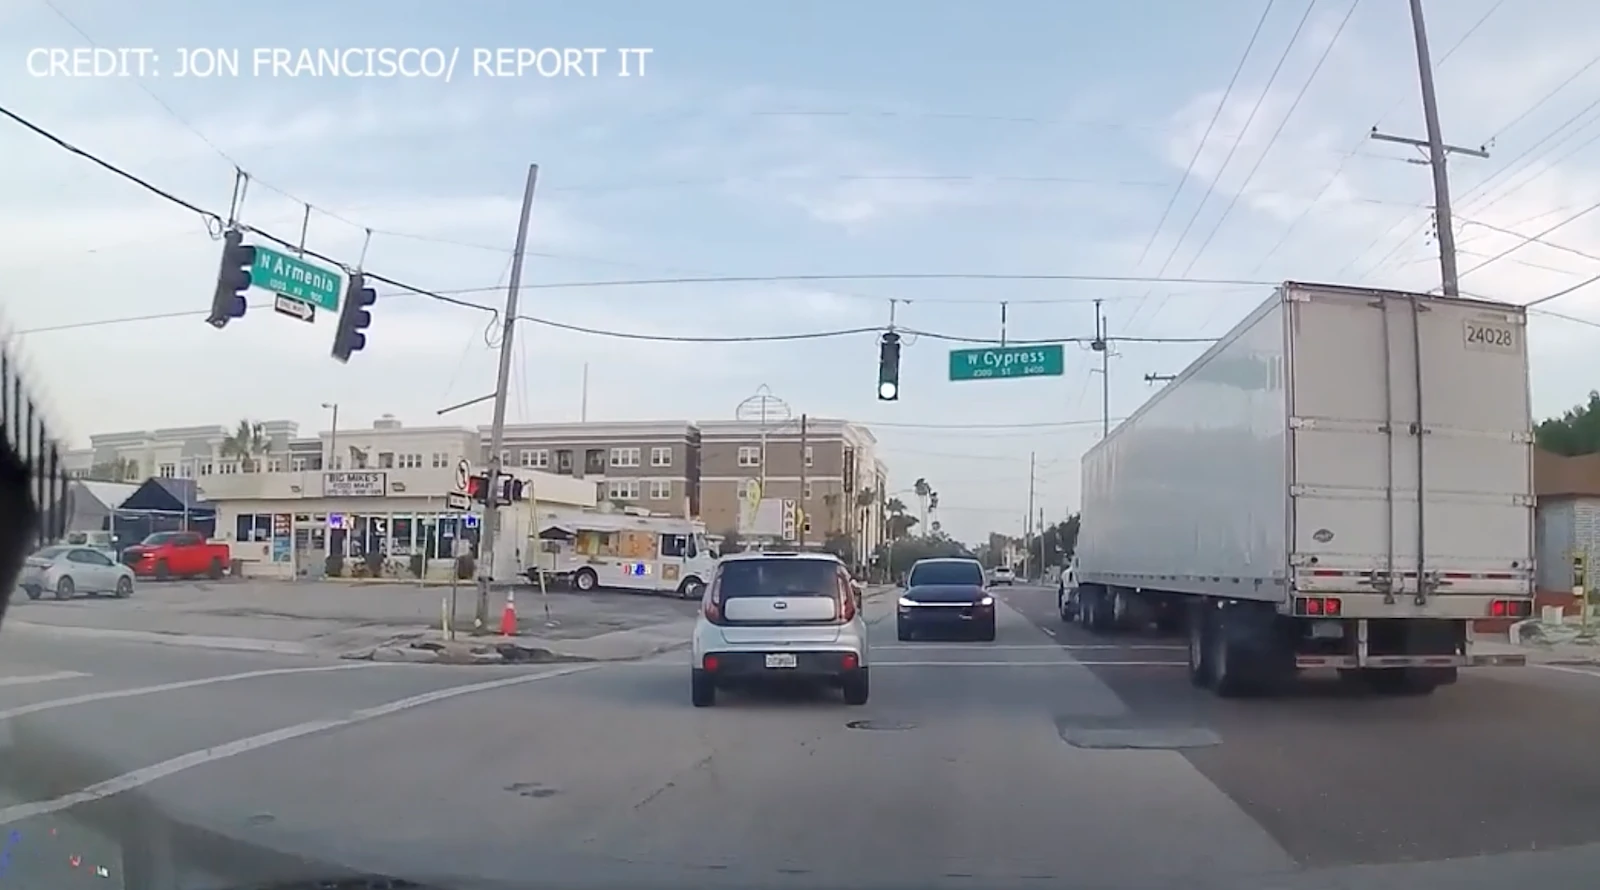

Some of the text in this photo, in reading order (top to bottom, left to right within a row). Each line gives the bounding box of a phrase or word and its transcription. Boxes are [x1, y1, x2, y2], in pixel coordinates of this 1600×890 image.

[260, 253, 334, 293] N Armenia
[1467, 325, 1512, 346] 24028
[967, 350, 1046, 368] W Cypress
[785, 501, 794, 538] VAPE
